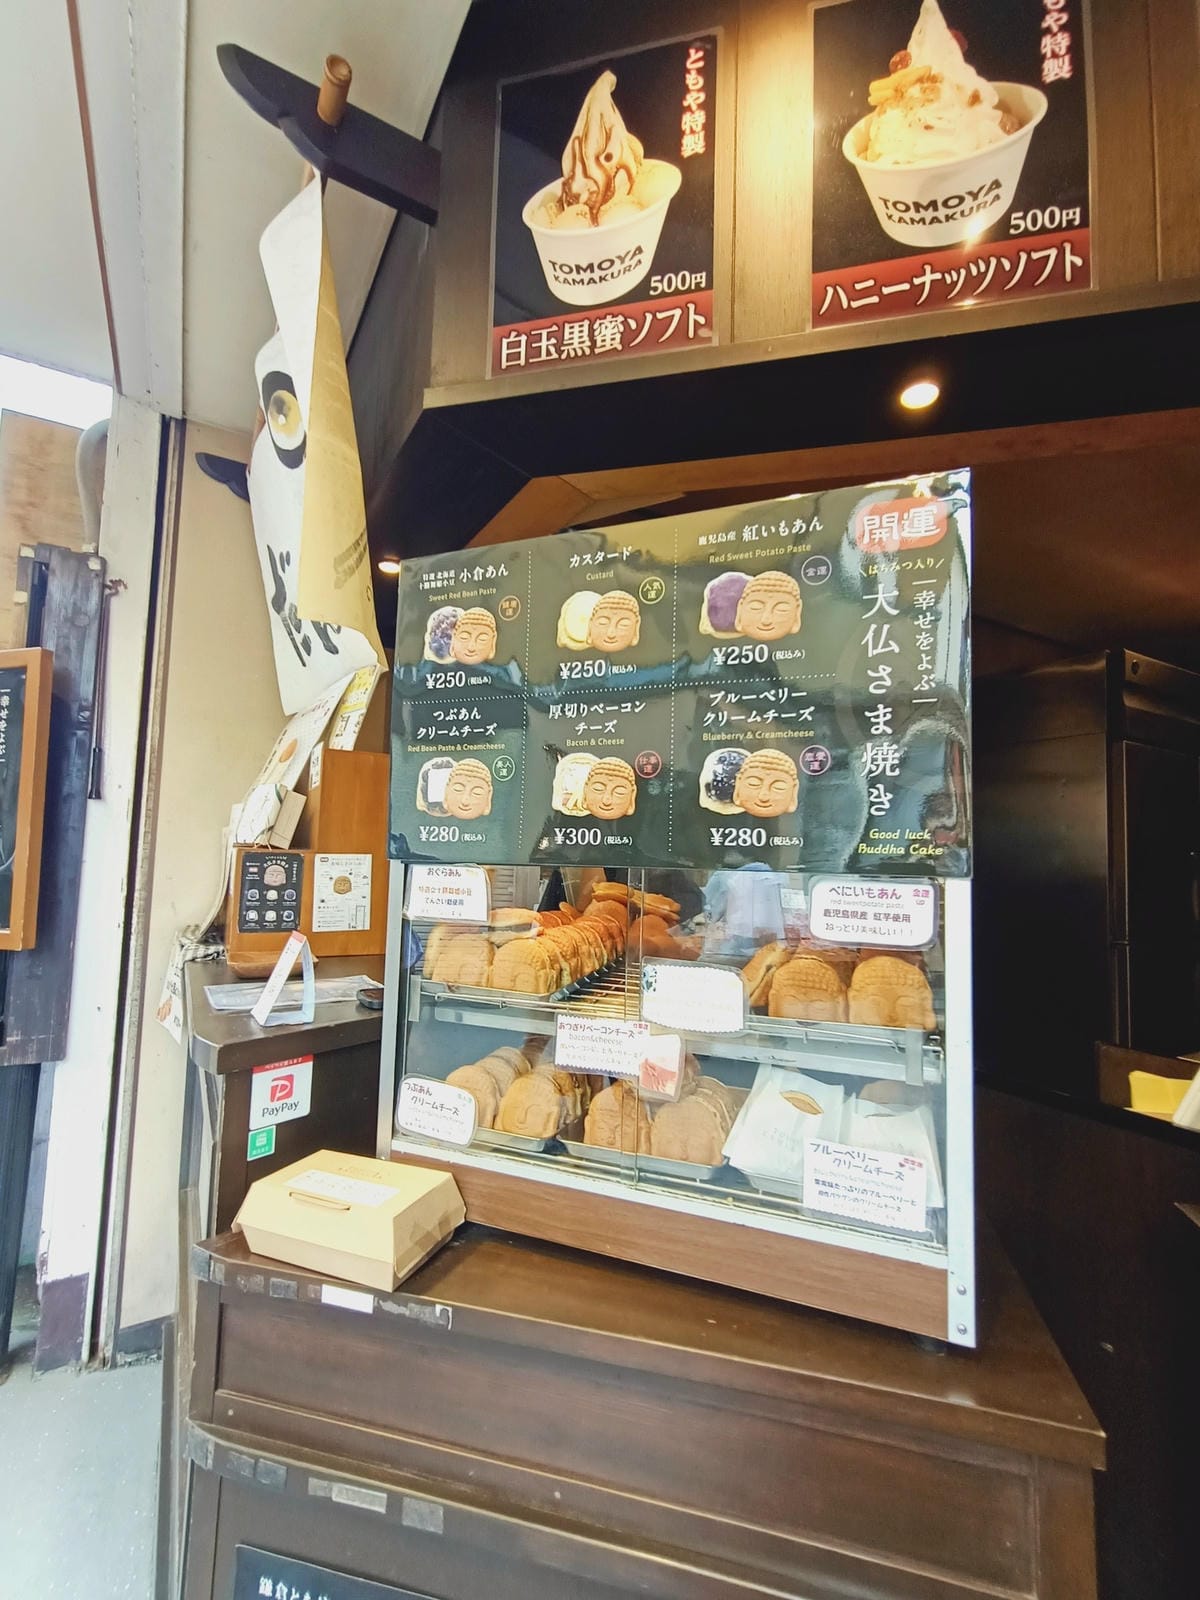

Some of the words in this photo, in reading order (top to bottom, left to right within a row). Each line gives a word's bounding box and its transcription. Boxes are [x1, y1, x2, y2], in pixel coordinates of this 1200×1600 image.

[681, 48, 705, 158] ともや特製
[879, 178, 1003, 214] TOMOYA
[886, 194, 1001, 226] KAMAKURA
[1009, 206, 1081, 234] 500円
[549, 245, 644, 275] TOMOYA
[553, 259, 643, 287] KAMAKURA
[650, 271, 706, 295] 500円
[819, 242, 1083, 315] ハニーナッツソフト
[500, 302, 706, 369] 白玉黒蜜ソフト
[742, 516, 824, 542] 紅いもあん
[862, 506, 941, 545] 開運
[569, 545, 632, 569] カスタード
[709, 554, 725, 563] Red
[727, 551, 753, 561] Sweet
[755, 547, 785, 557] Potato
[787, 543, 812, 554] Paste
[459, 563, 509, 583] 小倉あん
[586, 570, 614, 582] Custard
[449, 591, 461, 600] Red
[713, 643, 768, 665] ¥250
[559, 659, 606, 680] ¥250
[425, 671, 465, 689] ¥250
[708, 688, 807, 706] ブルーベリー
[861, 584, 900, 816] 大仏さま焼き
[432, 707, 482, 721] つぶあん
[549, 701, 646, 720] 厚切りベーコン
[703, 706, 815, 727] クリームチーズ
[416, 723, 498, 740] クリームチーズ
[575, 720, 618, 735] チーズ
[702, 731, 745, 741] Blueberry
[746, 731, 753, 740] &
[755, 729, 814, 739] Creamcheese
[407, 745, 421, 753] Red
[421, 744, 437, 752] Bean
[437, 743, 456, 752] Paste
[463, 742, 506, 751] Creamcheese
[566, 738, 588, 747] Bacon
[590, 738, 596, 746] &
[597, 737, 625, 746] Cheese
[419, 826, 459, 842] ¥280
[554, 828, 601, 845] ¥300
[710, 827, 766, 847] ¥280
[869, 828, 899, 840] Good
[905, 827, 931, 840] luck
[858, 843, 905, 854] Buddha
[909, 843, 943, 856] Cake
[829, 885, 902, 900] べにいもあん
[262, 1100, 300, 1117] PayPay
